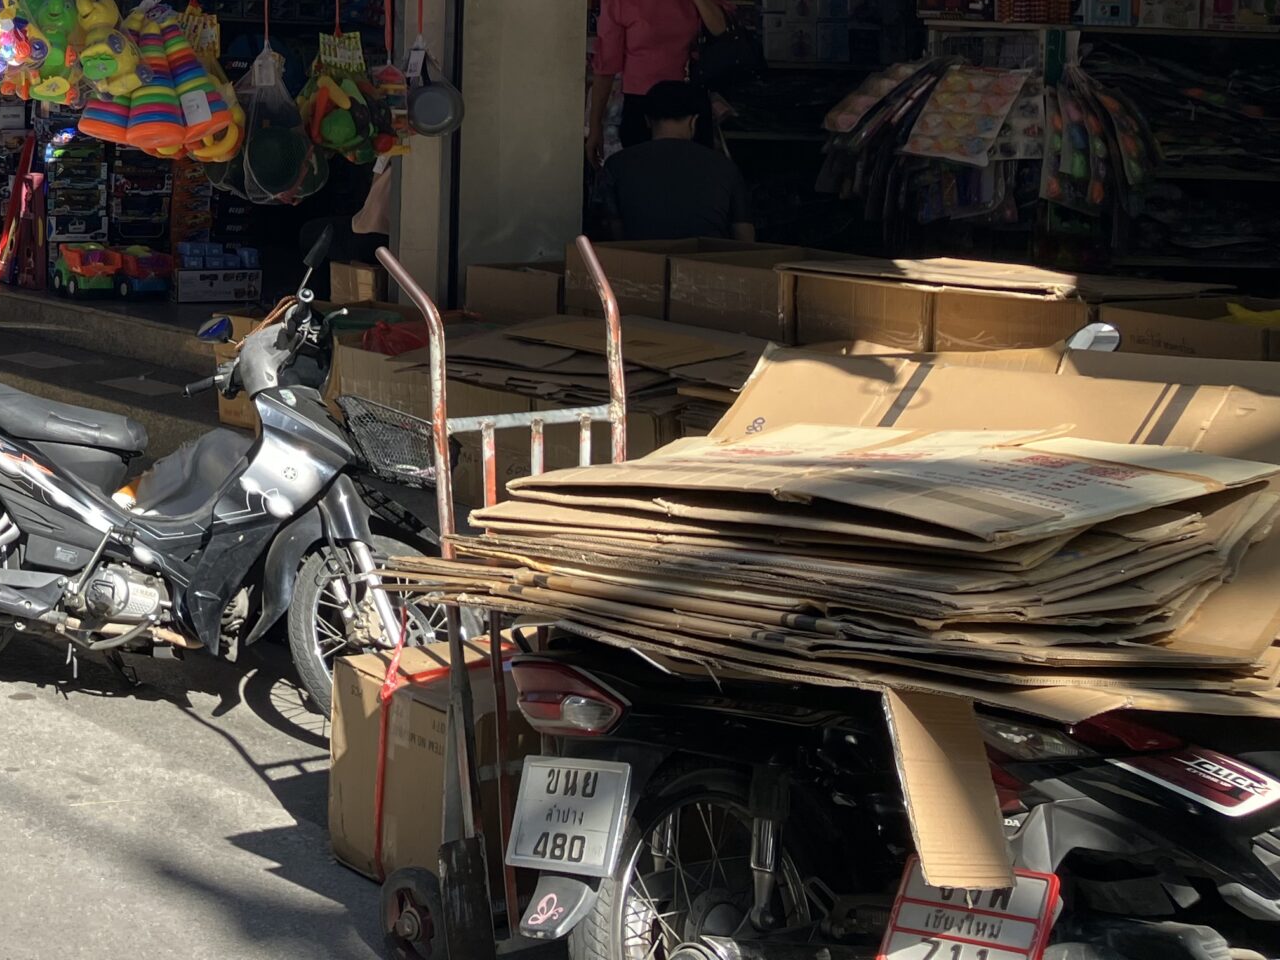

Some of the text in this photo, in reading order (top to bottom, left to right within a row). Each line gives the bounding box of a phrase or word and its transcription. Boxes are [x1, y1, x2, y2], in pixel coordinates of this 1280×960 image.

[546, 768, 598, 798] ขนย
[1192, 758, 1273, 796] CLICK
[545, 804, 584, 825] ลำปาง
[532, 831, 587, 863] 480
[924, 909, 1004, 940] เชียงใหม่
